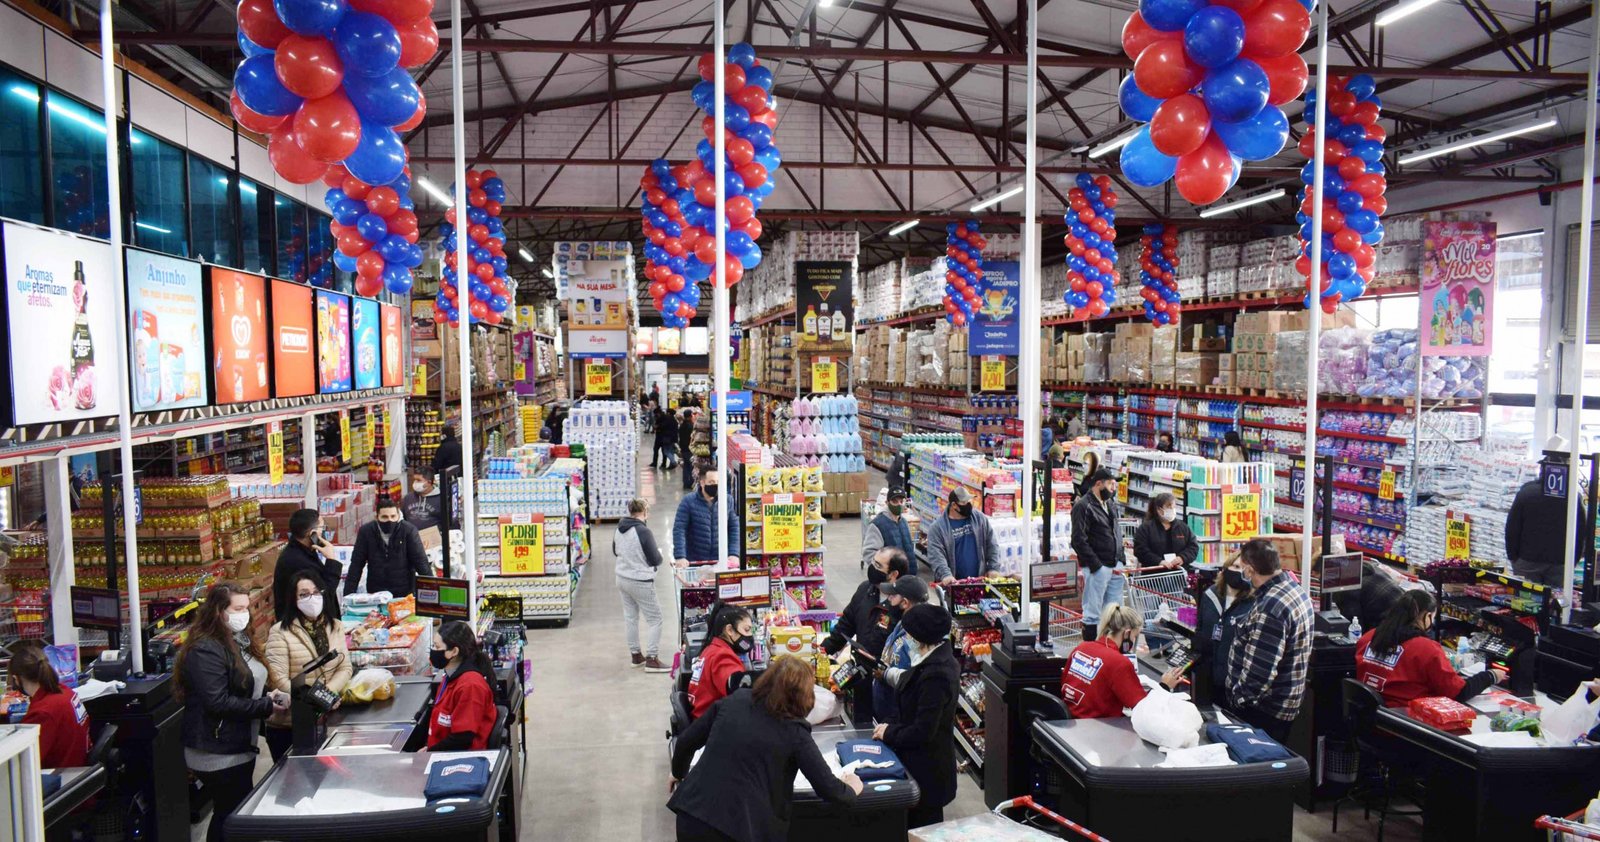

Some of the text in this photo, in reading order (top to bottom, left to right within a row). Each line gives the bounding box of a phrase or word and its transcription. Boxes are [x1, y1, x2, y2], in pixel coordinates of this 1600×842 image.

[1443, 241, 1477, 263] Mil
[25, 264, 54, 282] Aromas
[147, 264, 186, 286] Anjinho
[1445, 256, 1494, 284] flores
[17, 281, 67, 296] que eternizam
[586, 283, 599, 291] SUA
[27, 293, 53, 307] afetos.
[1292, 479, 1305, 498] 02
[1547, 473, 1563, 491] 01
[504, 524, 538, 539] PEDRA
[1226, 510, 1257, 536] 5,99
